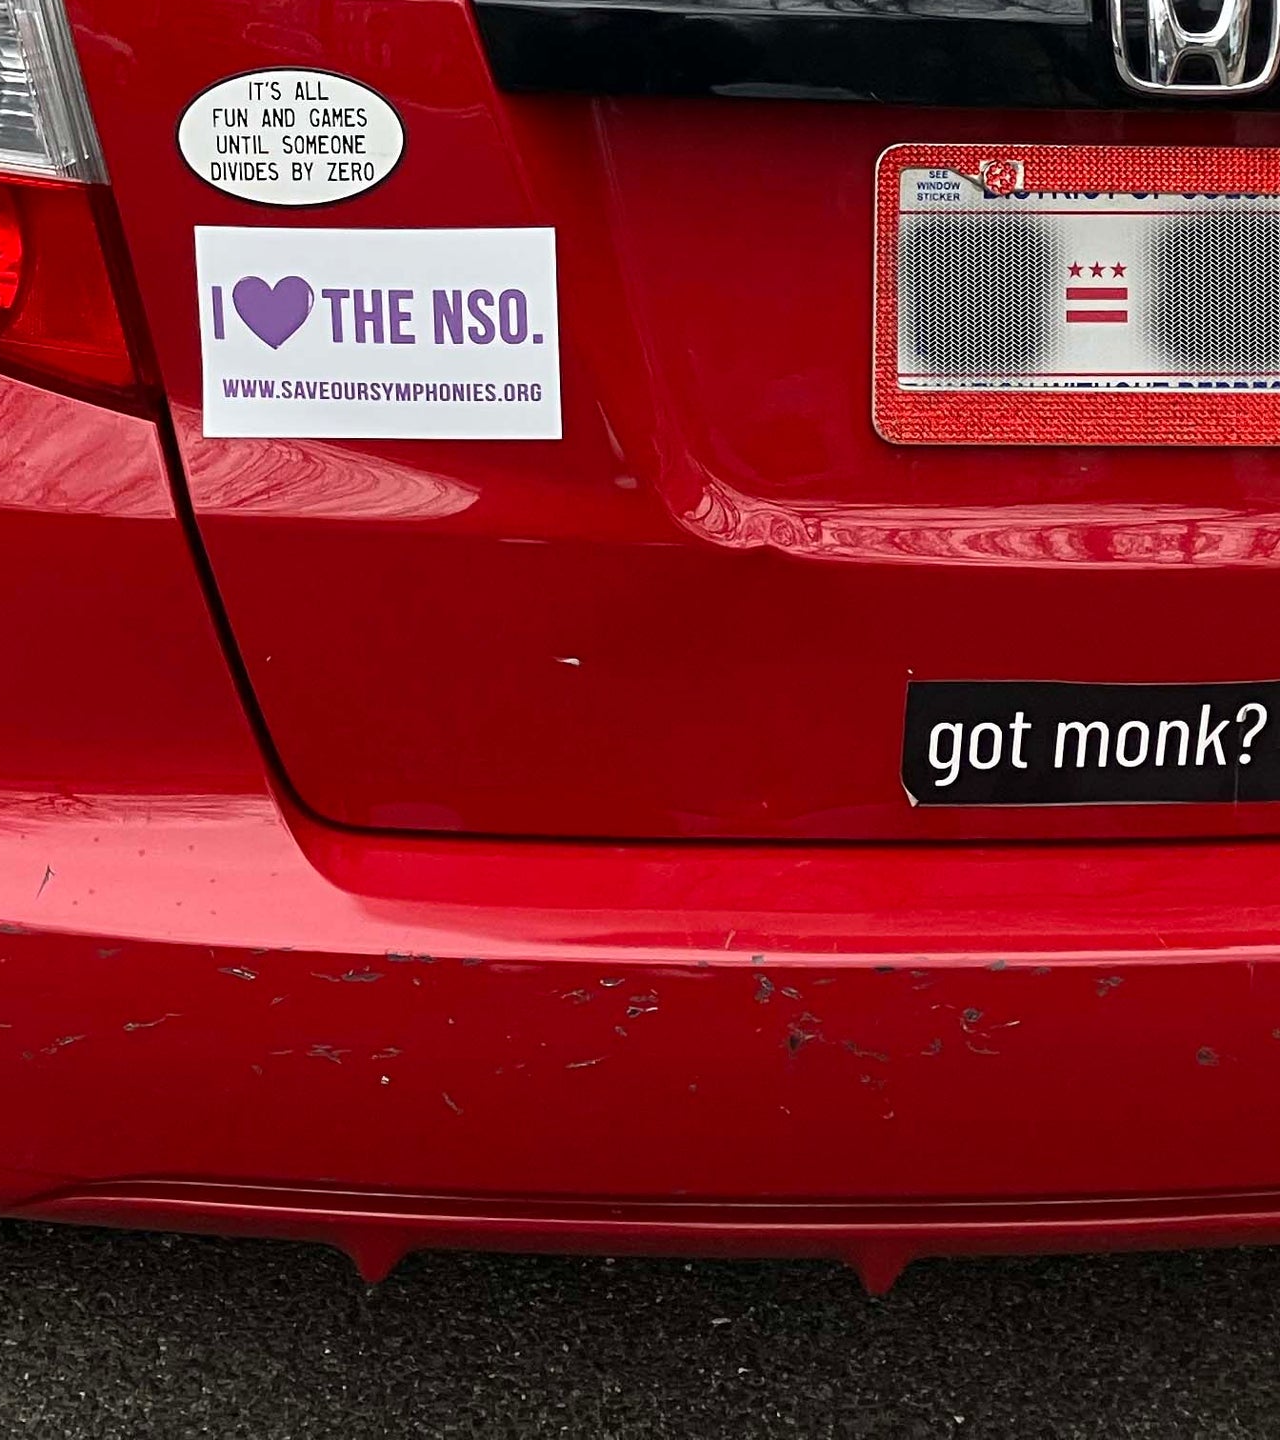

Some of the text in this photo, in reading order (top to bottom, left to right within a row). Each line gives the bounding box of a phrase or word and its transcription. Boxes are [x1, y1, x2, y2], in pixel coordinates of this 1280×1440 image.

[248, 81, 329, 101] IT'S ALL
[212, 108, 368, 128] FUN AND GAMES
[216, 135, 366, 155] UNTIL SOMEONE
[210, 162, 375, 182] DIVIDES BY ZERO
[928, 170, 948, 179] SEE
[917, 181, 961, 191] WINDOW
[917, 192, 961, 202] STICKER
[211, 285, 544, 345] I THE NSO.
[222, 378, 542, 403] WWW.SAVEOURSYMPHONIES.ORG
[927, 701, 1268, 787] got monk?
